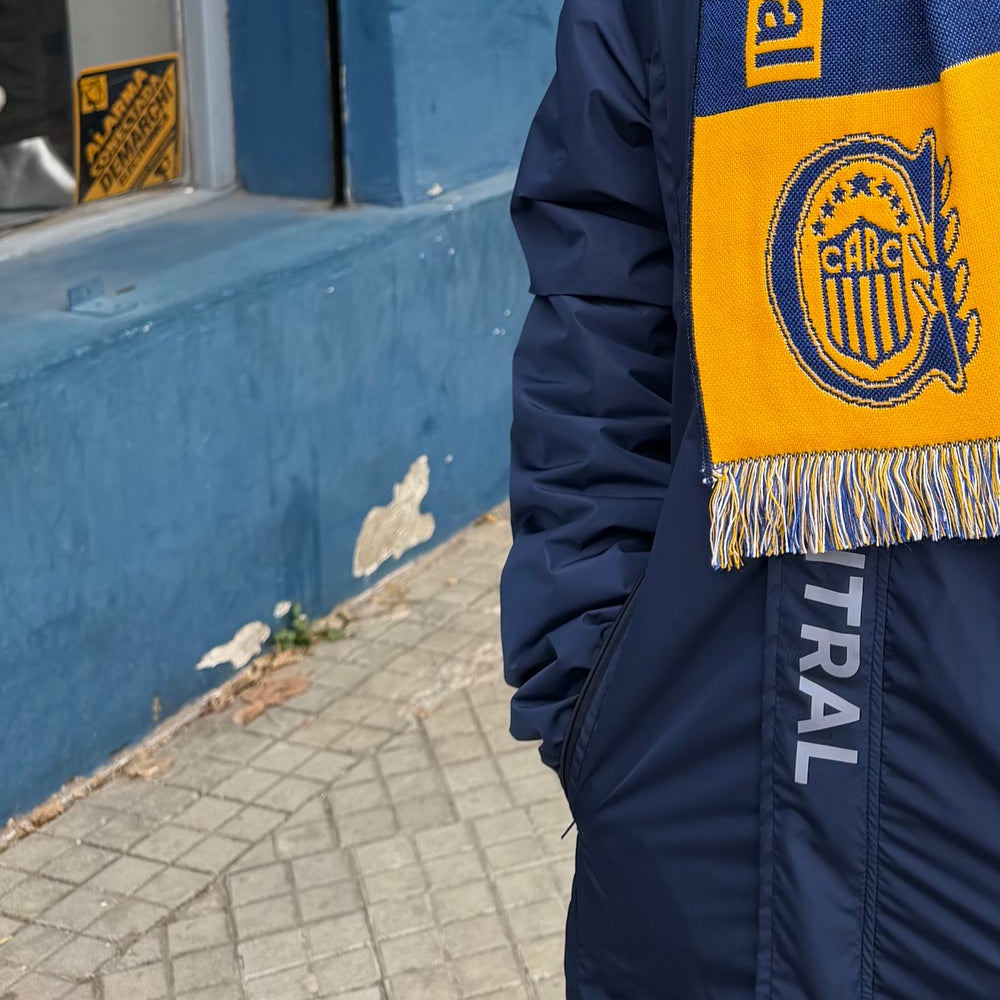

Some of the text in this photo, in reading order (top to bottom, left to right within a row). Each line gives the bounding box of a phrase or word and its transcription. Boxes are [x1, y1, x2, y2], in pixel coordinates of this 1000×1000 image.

[86, 68, 148, 164] ALARMA
[90, 74, 163, 178] CONECTADA
[100, 84, 173, 193] DEMARCHI
[820, 227, 901, 275] CARC
